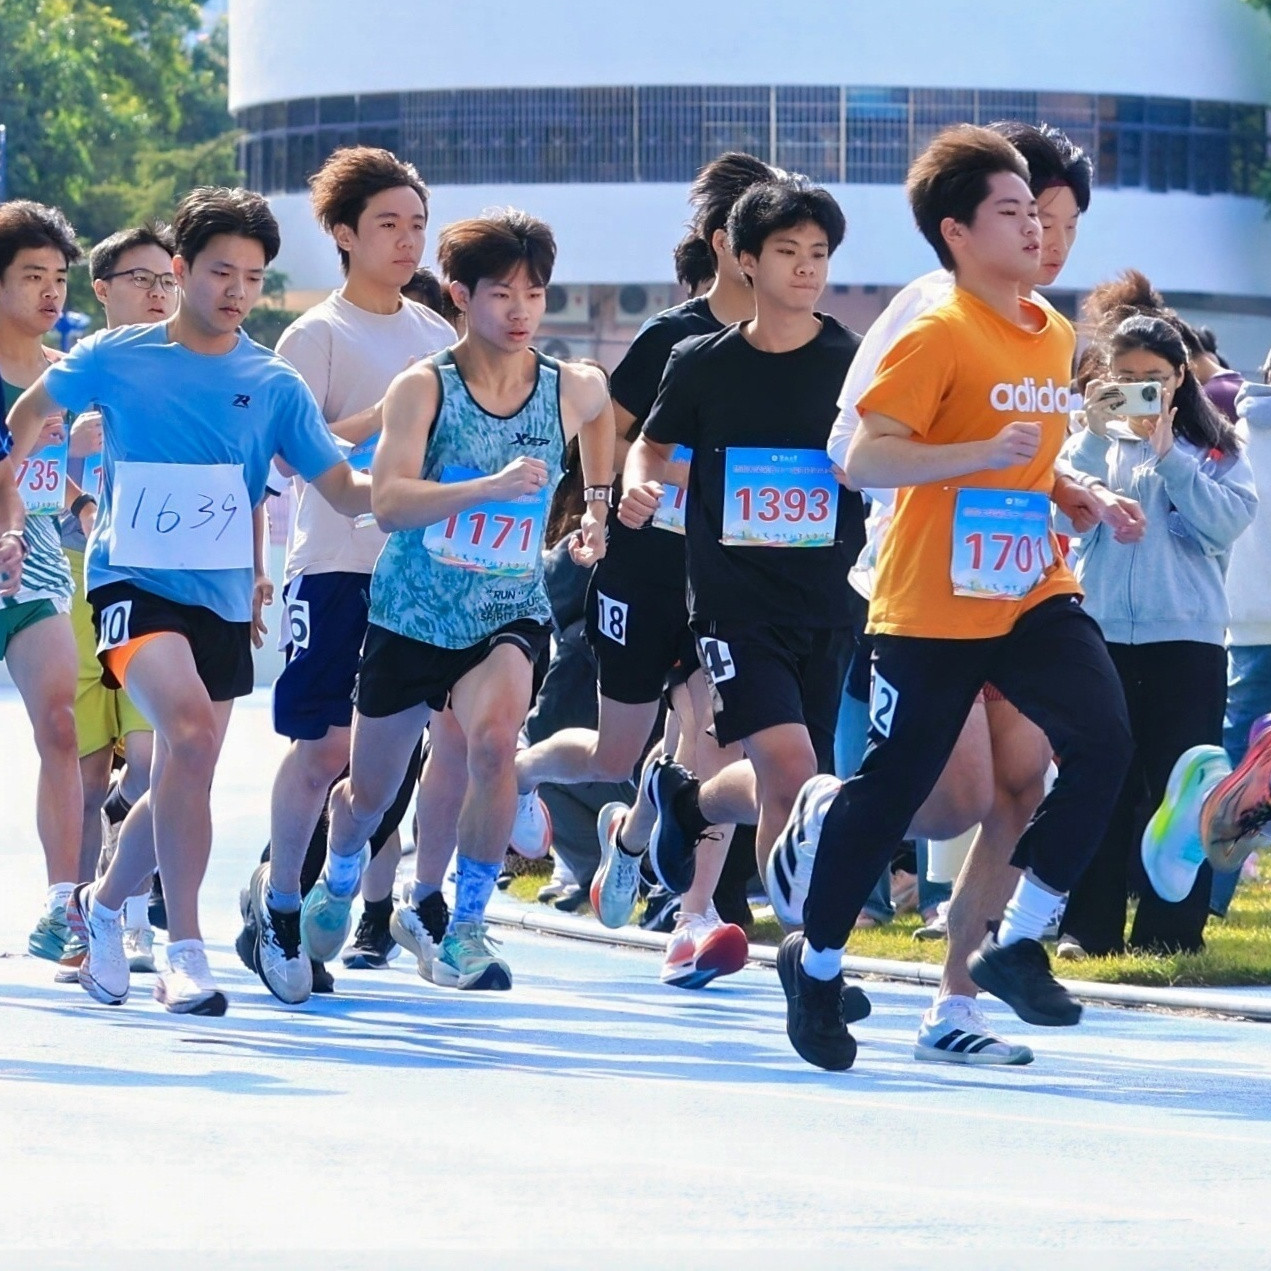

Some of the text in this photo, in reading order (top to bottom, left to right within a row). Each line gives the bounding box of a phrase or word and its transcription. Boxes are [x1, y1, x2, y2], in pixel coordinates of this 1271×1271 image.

[990, 377, 1069, 413] adida
[16, 459, 59, 491] 735
[131, 487, 237, 541] 1639
[735, 488, 829, 522] 1393
[445, 513, 532, 551] 1171
[965, 533, 1046, 573] 1701
[102, 606, 126, 644] 10
[288, 604, 307, 642] 6
[600, 599, 624, 640] 18
